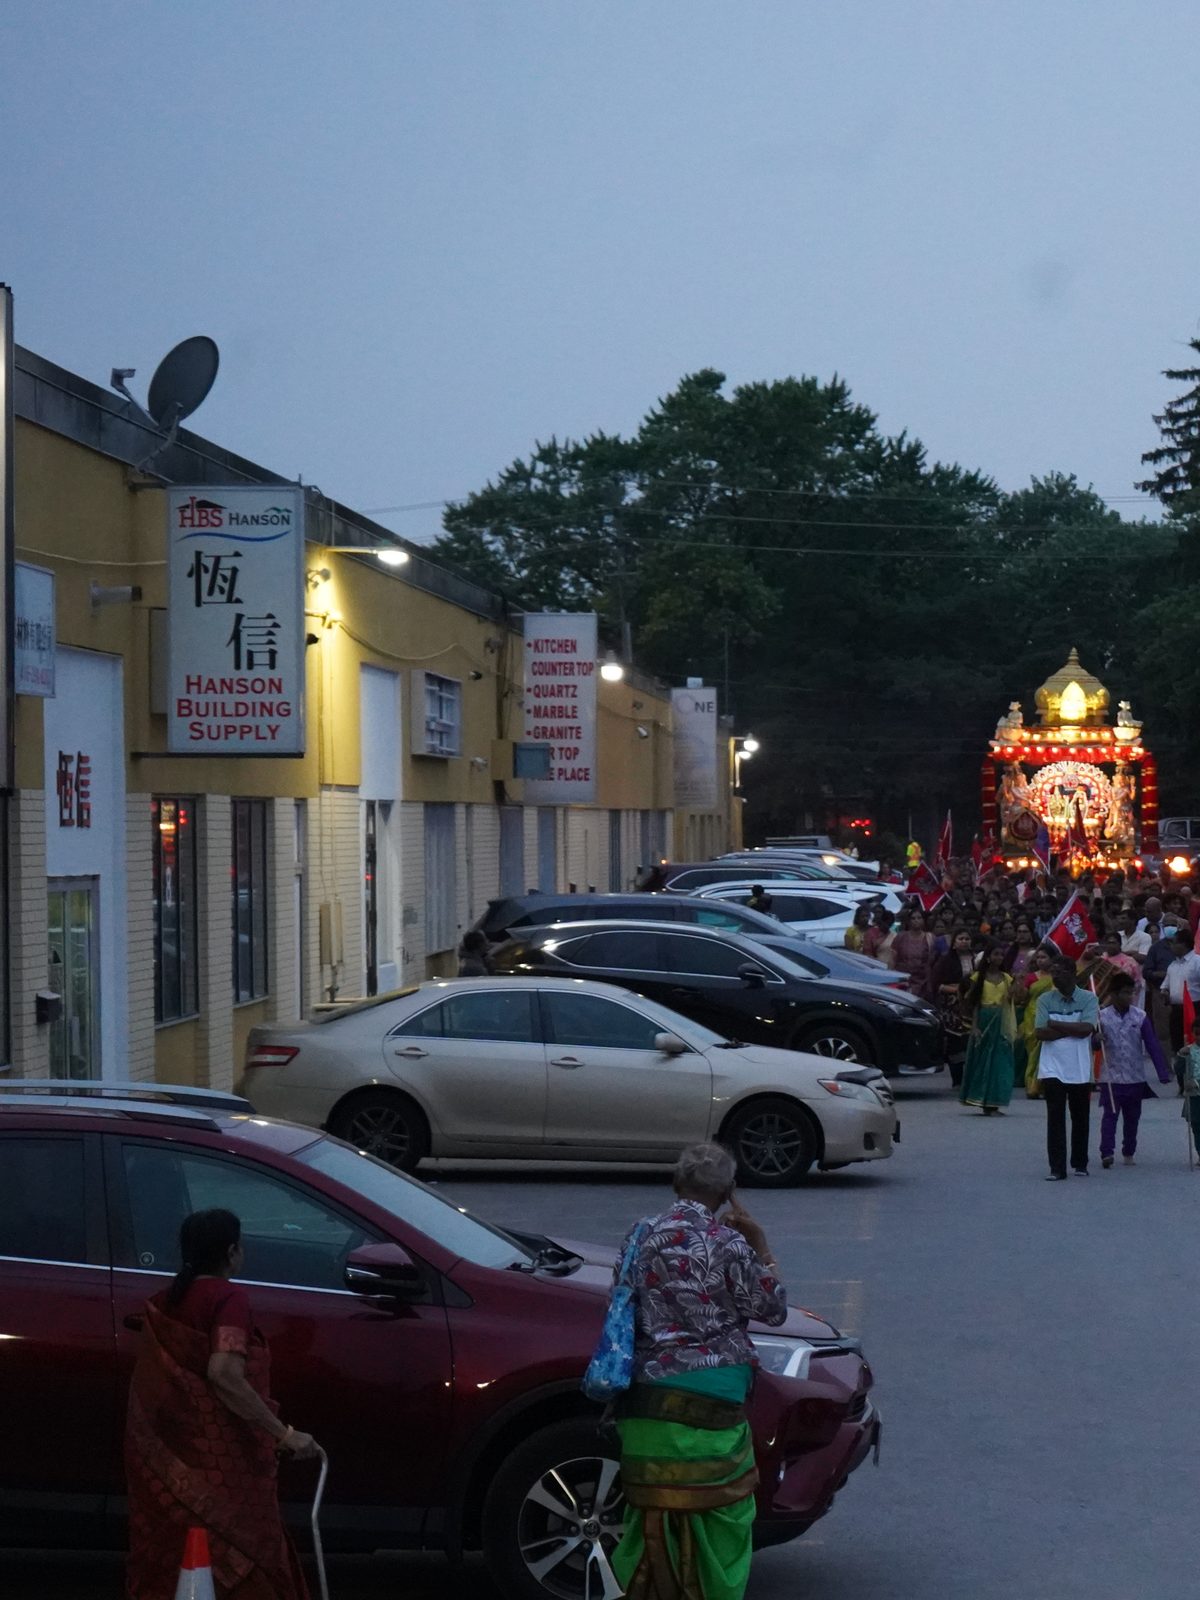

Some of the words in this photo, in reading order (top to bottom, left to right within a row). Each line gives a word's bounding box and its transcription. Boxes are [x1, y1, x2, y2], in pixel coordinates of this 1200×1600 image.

[178, 502, 223, 528] HBS
[228, 512, 291, 526] HANSON
[533, 639, 577, 654] KITCHEN
[531, 661, 575, 677] COUNTER
[576, 662, 594, 677] TOP
[185, 675, 283, 695] HANSON
[533, 684, 578, 699] QUARTZ
[176, 698, 292, 718] BUILDING
[533, 705, 578, 720] MARBLE
[188, 721, 281, 741] SUPPLY
[533, 726, 583, 741] GRANITE
[558, 746, 580, 761] TOP
[557, 767, 591, 782] PLACE
